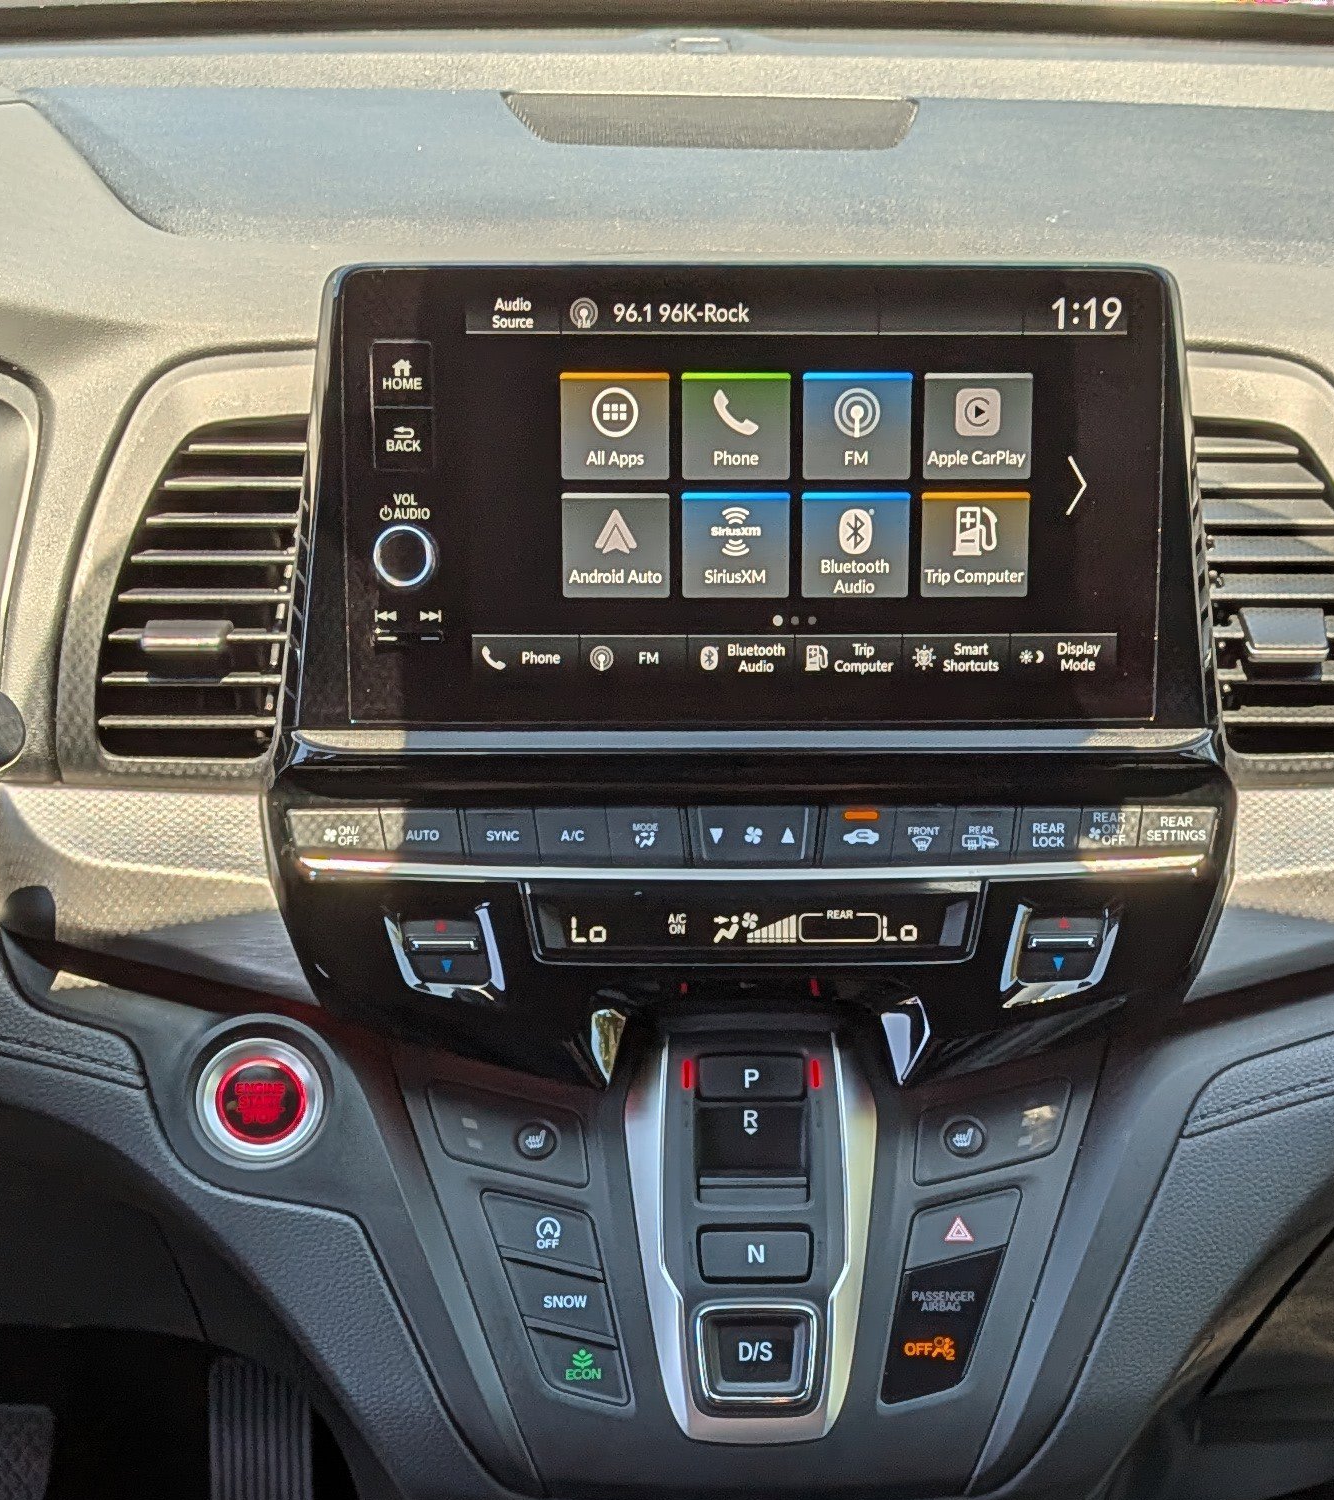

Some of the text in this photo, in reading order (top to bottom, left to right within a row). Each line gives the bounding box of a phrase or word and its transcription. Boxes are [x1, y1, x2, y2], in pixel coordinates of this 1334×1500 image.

[494, 298, 532, 311] Audio
[613, 303, 749, 323] 96.1 96K-Rock
[1052, 296, 1123, 330] 1:19
[492, 315, 534, 329] Source
[382, 377, 423, 391] HOME
[385, 439, 421, 453] BACK
[586, 451, 645, 469] All Apps
[712, 450, 759, 466] Phone
[844, 451, 869, 466] FM
[927, 450, 1026, 468] Apple CarPlay
[394, 494, 417, 506] VOL
[394, 507, 430, 520] AUDIO
[820, 559, 890, 574] Bluetooth
[568, 569, 663, 585] Android Auto
[704, 569, 766, 584] SiriusXM
[924, 569, 1025, 586] Trip Computer
[833, 579, 875, 594] Audio
[727, 643, 786, 657] Bluetooth
[852, 643, 875, 658] Trip
[953, 642, 989, 657] Smart
[1057, 642, 1101, 658] Display
[521, 651, 561, 665] Phone
[638, 652, 660, 665] FM
[738, 659, 774, 673] Audio
[834, 660, 894, 675] Computer
[942, 659, 999, 673] Shortcuts
[1060, 659, 1096, 672] Mode
[1093, 811, 1126, 824] REAR
[1160, 815, 1194, 828] REAR
[632, 823, 659, 832] MODE
[907, 826, 940, 836] FRONT
[968, 825, 994, 835] REAR
[1032, 822, 1065, 835] REAR
[338, 836, 360, 846] OFF
[406, 829, 440, 842] AUTO
[486, 830, 520, 842] SYNC
[560, 830, 585, 842] A/C
[1032, 835, 1065, 848] LOCK
[1101, 833, 1126, 846] OFF
[1146, 828, 1206, 842] SETTINGS
[668, 913, 686, 925] A/C
[826, 909, 854, 920] REAR
[571, 916, 607, 943] Lo
[669, 924, 686, 935] ON
[882, 916, 918, 942] Lo
[744, 1069, 760, 1088] P
[235, 1082, 285, 1095] ENGINE
[744, 1110, 758, 1127] R
[536, 1239, 559, 1249] OFF
[747, 1245, 765, 1262] N
[543, 1295, 587, 1309] SNOW
[912, 1291, 975, 1302] PASSENGER
[921, 1301, 961, 1312] AIRBAG
[738, 1341, 773, 1362] D/S
[904, 1342, 933, 1356] OFF
[565, 1368, 602, 1380] ECON
